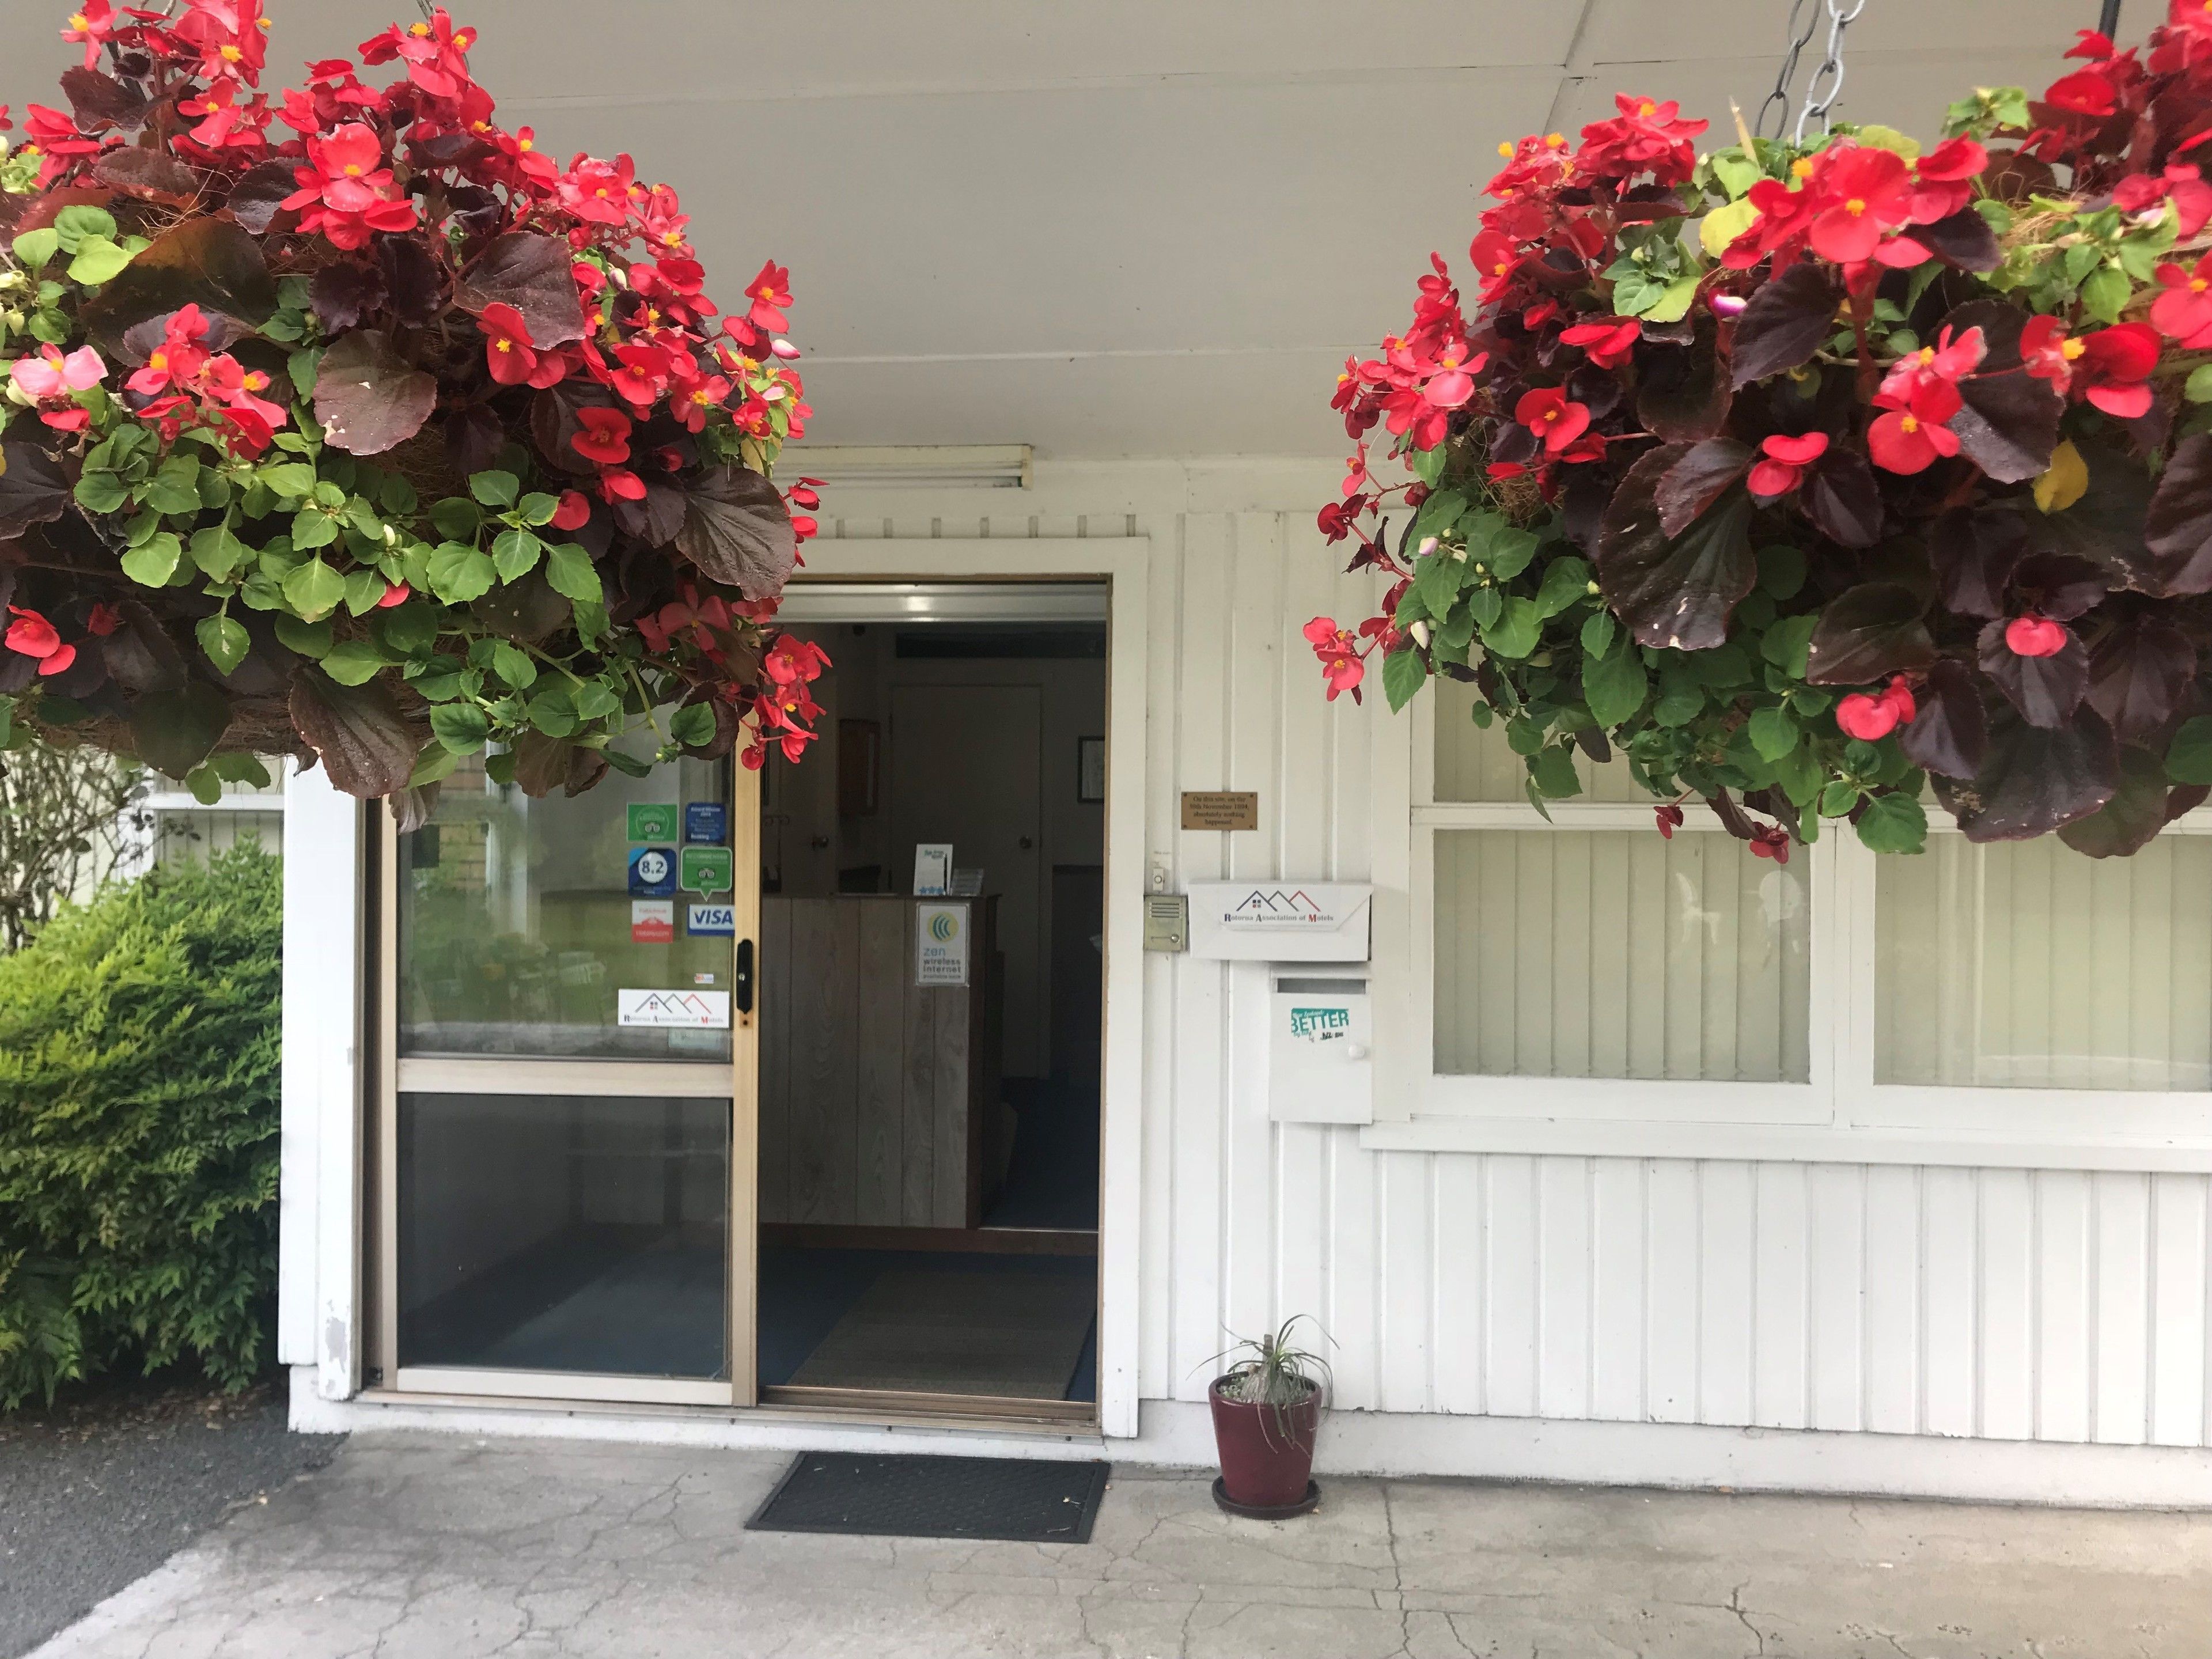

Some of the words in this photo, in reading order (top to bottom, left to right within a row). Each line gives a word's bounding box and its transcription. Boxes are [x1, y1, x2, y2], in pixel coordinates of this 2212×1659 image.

[642, 861, 664, 873] 8.2
[694, 909, 733, 925] VISA
[1224, 914, 1253, 922] Rotorua
[1256, 914, 1297, 922] Association
[1308, 914, 1334, 922] Motels
[923, 948, 946, 957] zen
[923, 957, 961, 965] wireless
